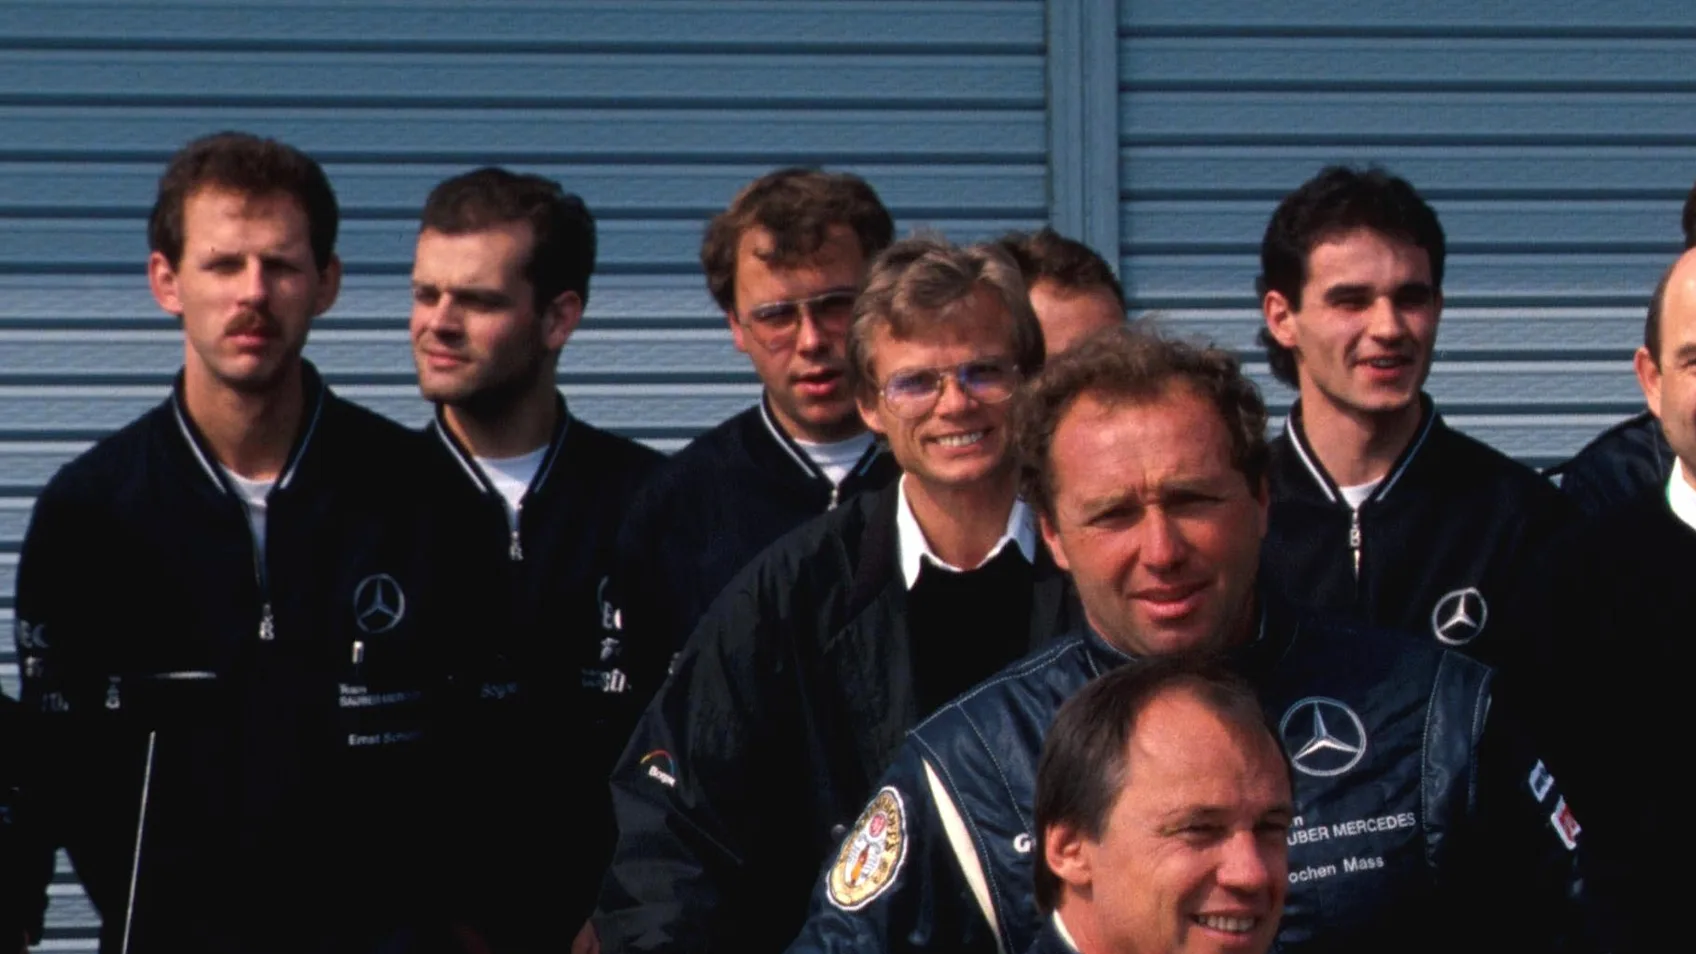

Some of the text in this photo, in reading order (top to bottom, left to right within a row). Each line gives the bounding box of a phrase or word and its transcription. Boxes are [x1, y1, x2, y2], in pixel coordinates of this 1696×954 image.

[1332, 811, 1417, 838] MERCEDES
[1288, 855, 1385, 884] ochen Mass
